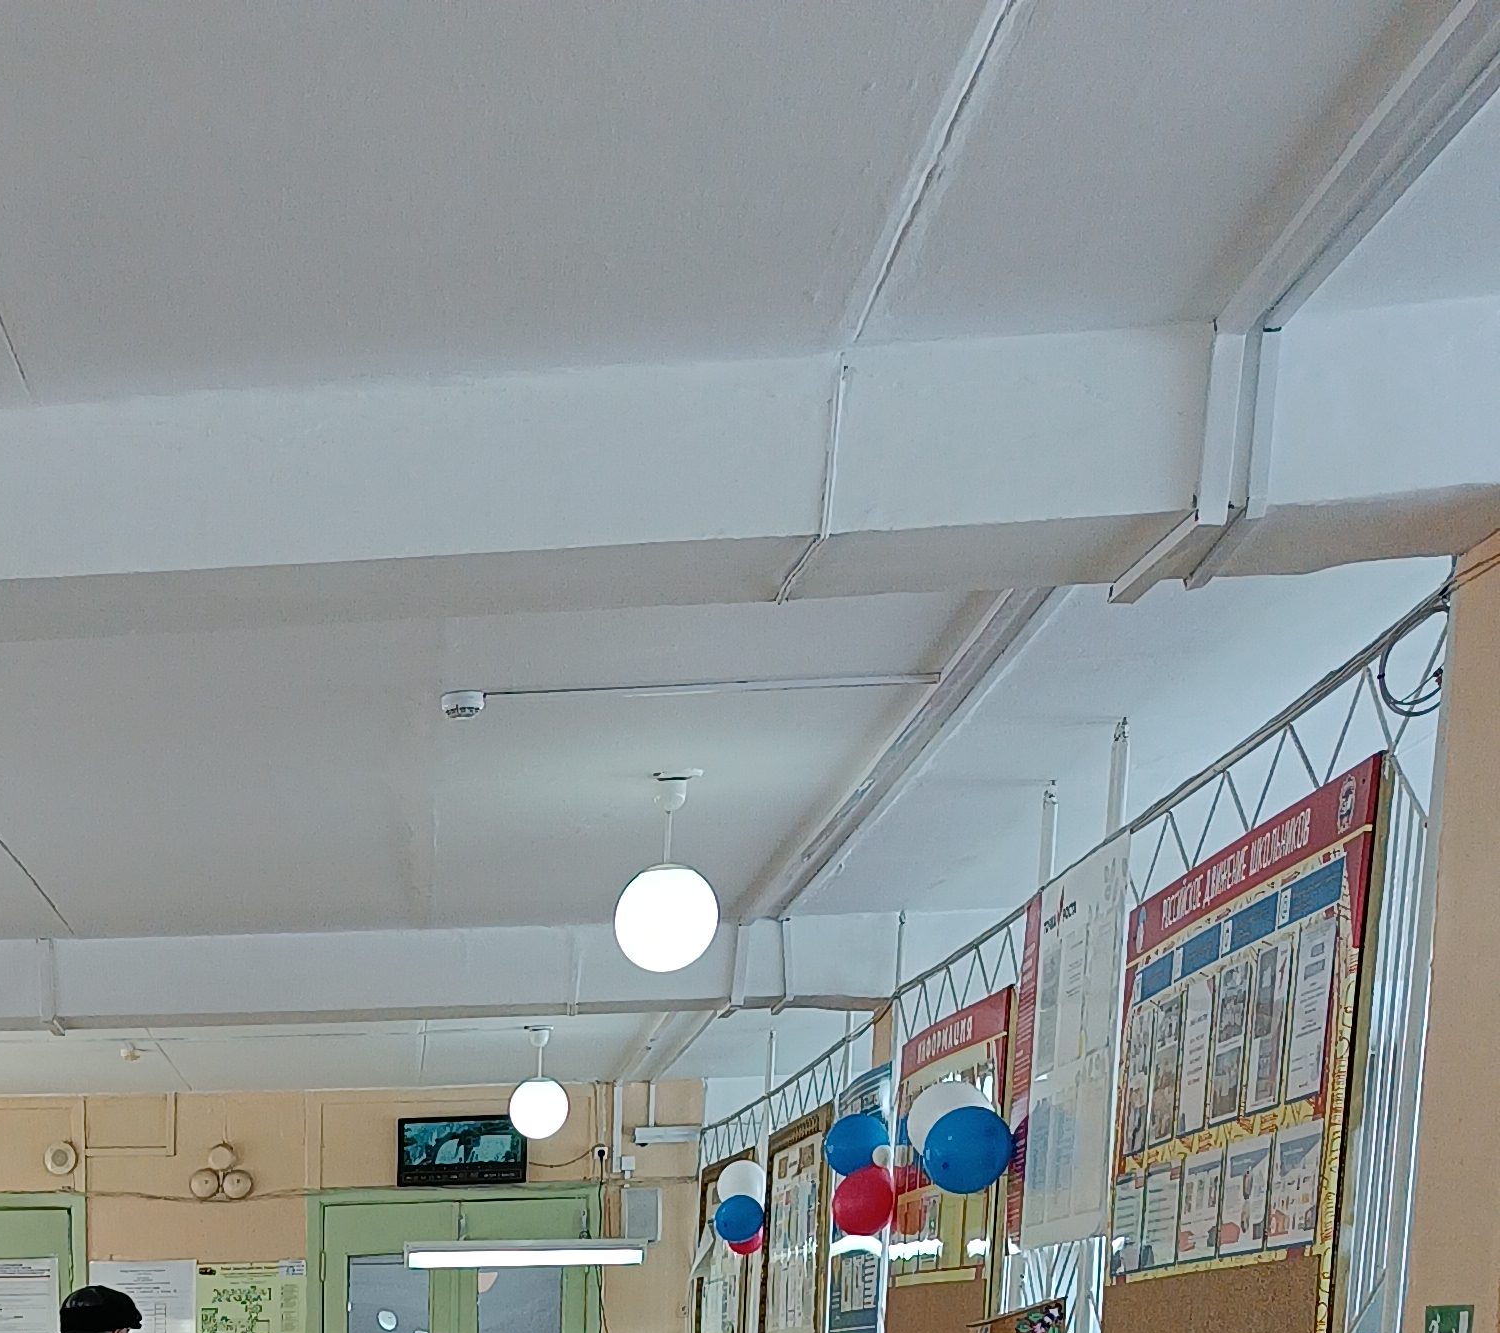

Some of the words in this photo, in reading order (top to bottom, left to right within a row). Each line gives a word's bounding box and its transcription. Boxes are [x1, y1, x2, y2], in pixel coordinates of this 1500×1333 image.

[1161, 874, 1203, 930] РОССИЙСКОЕ
[1202, 845, 1248, 909] ДВИЖЕНИЕ
[1249, 808, 1311, 877] ШКОЛЬНИКОВ
